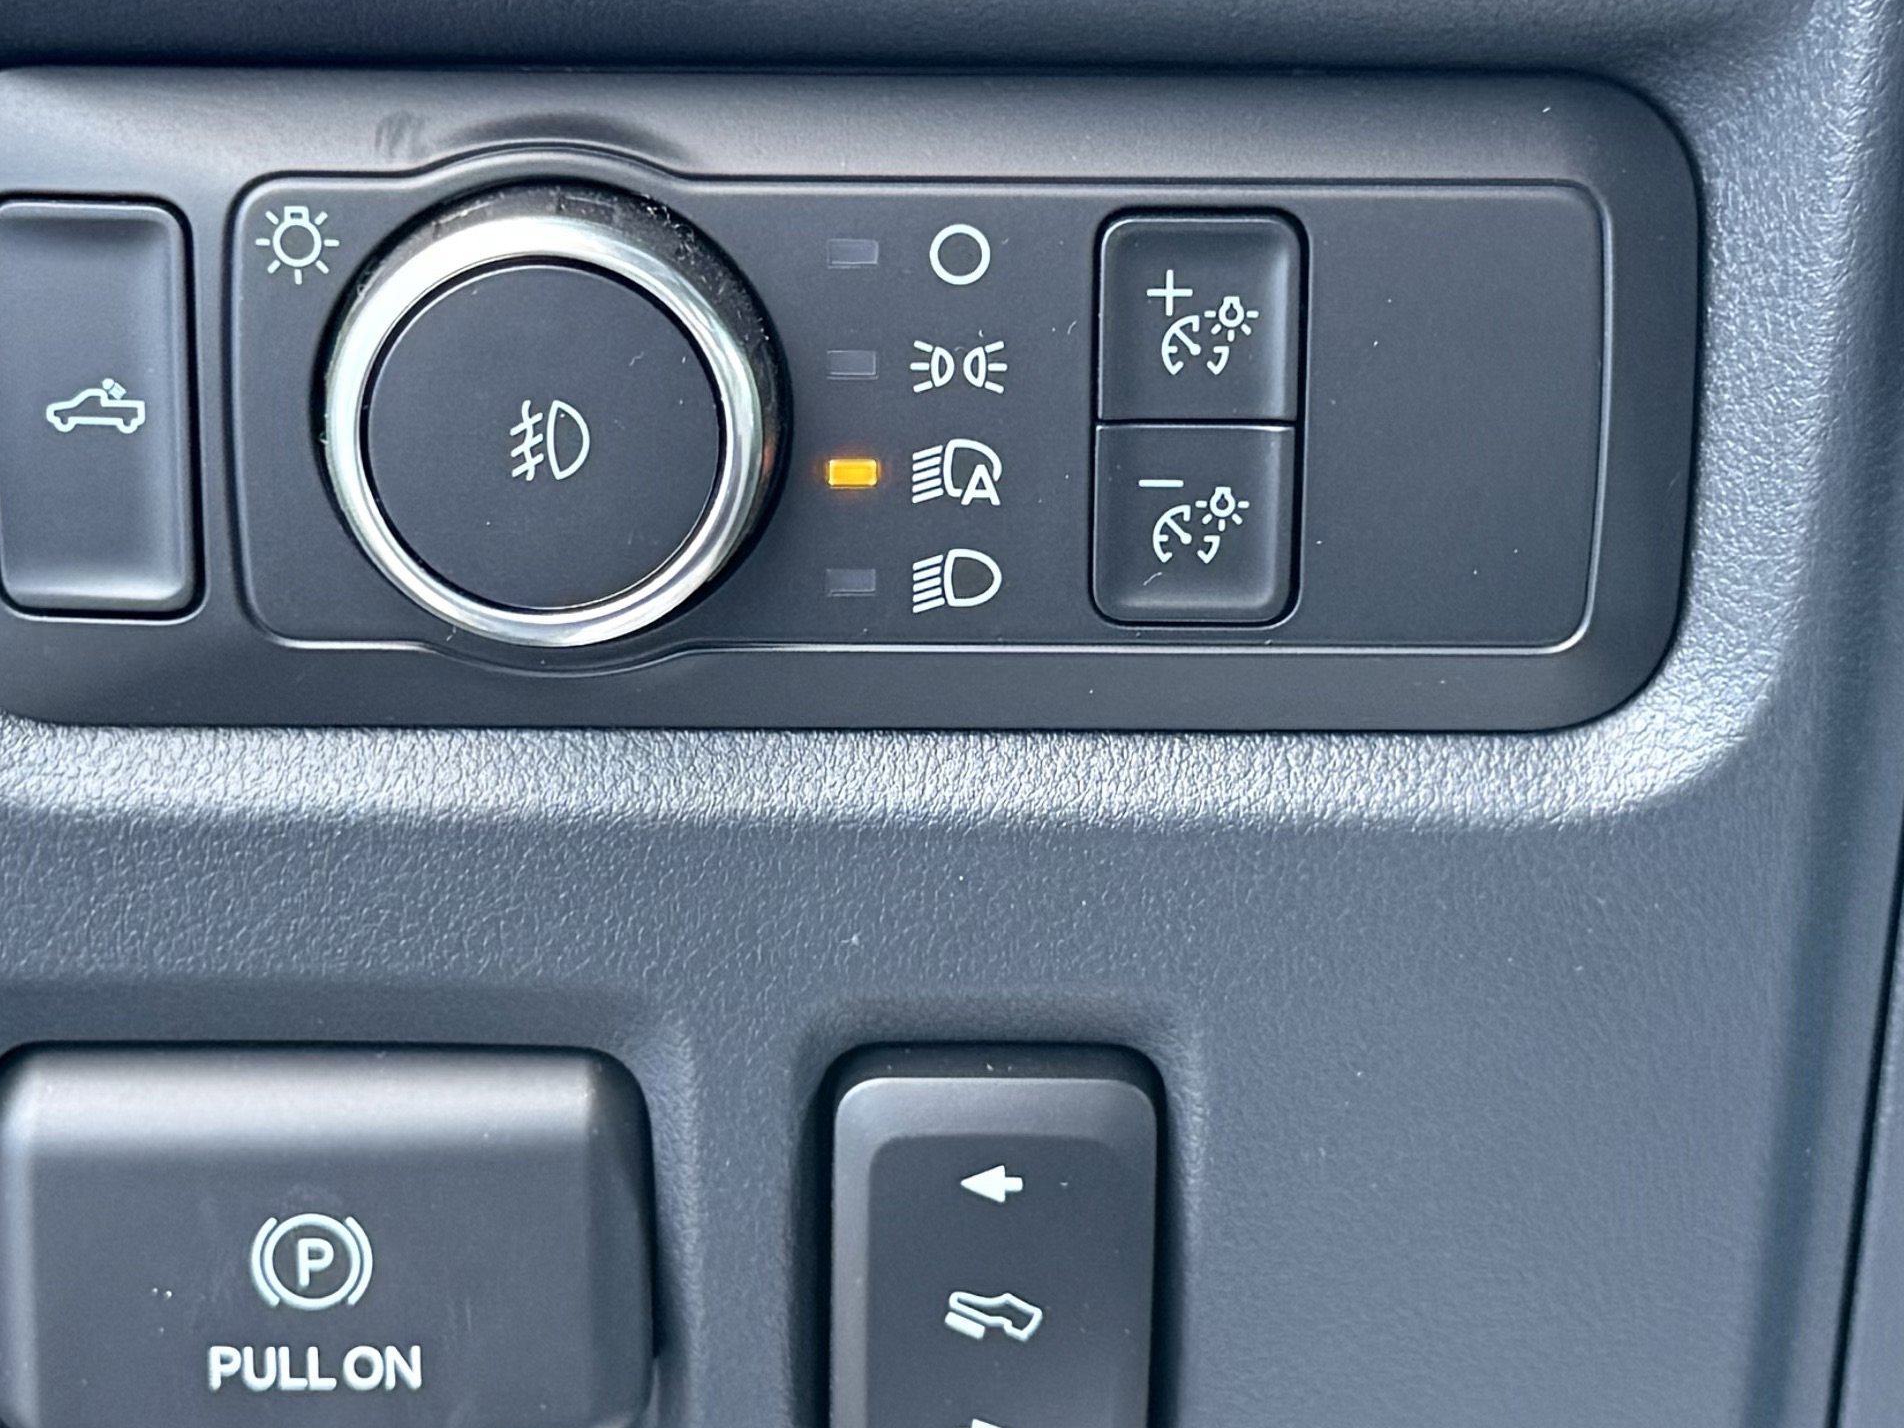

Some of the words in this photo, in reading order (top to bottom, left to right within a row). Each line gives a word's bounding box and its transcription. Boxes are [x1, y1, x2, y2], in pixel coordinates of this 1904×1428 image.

[961, 463, 1001, 506] A
[297, 1237, 334, 1288] P
[208, 1345, 338, 1392] PULL
[342, 1344, 423, 1392] ON
